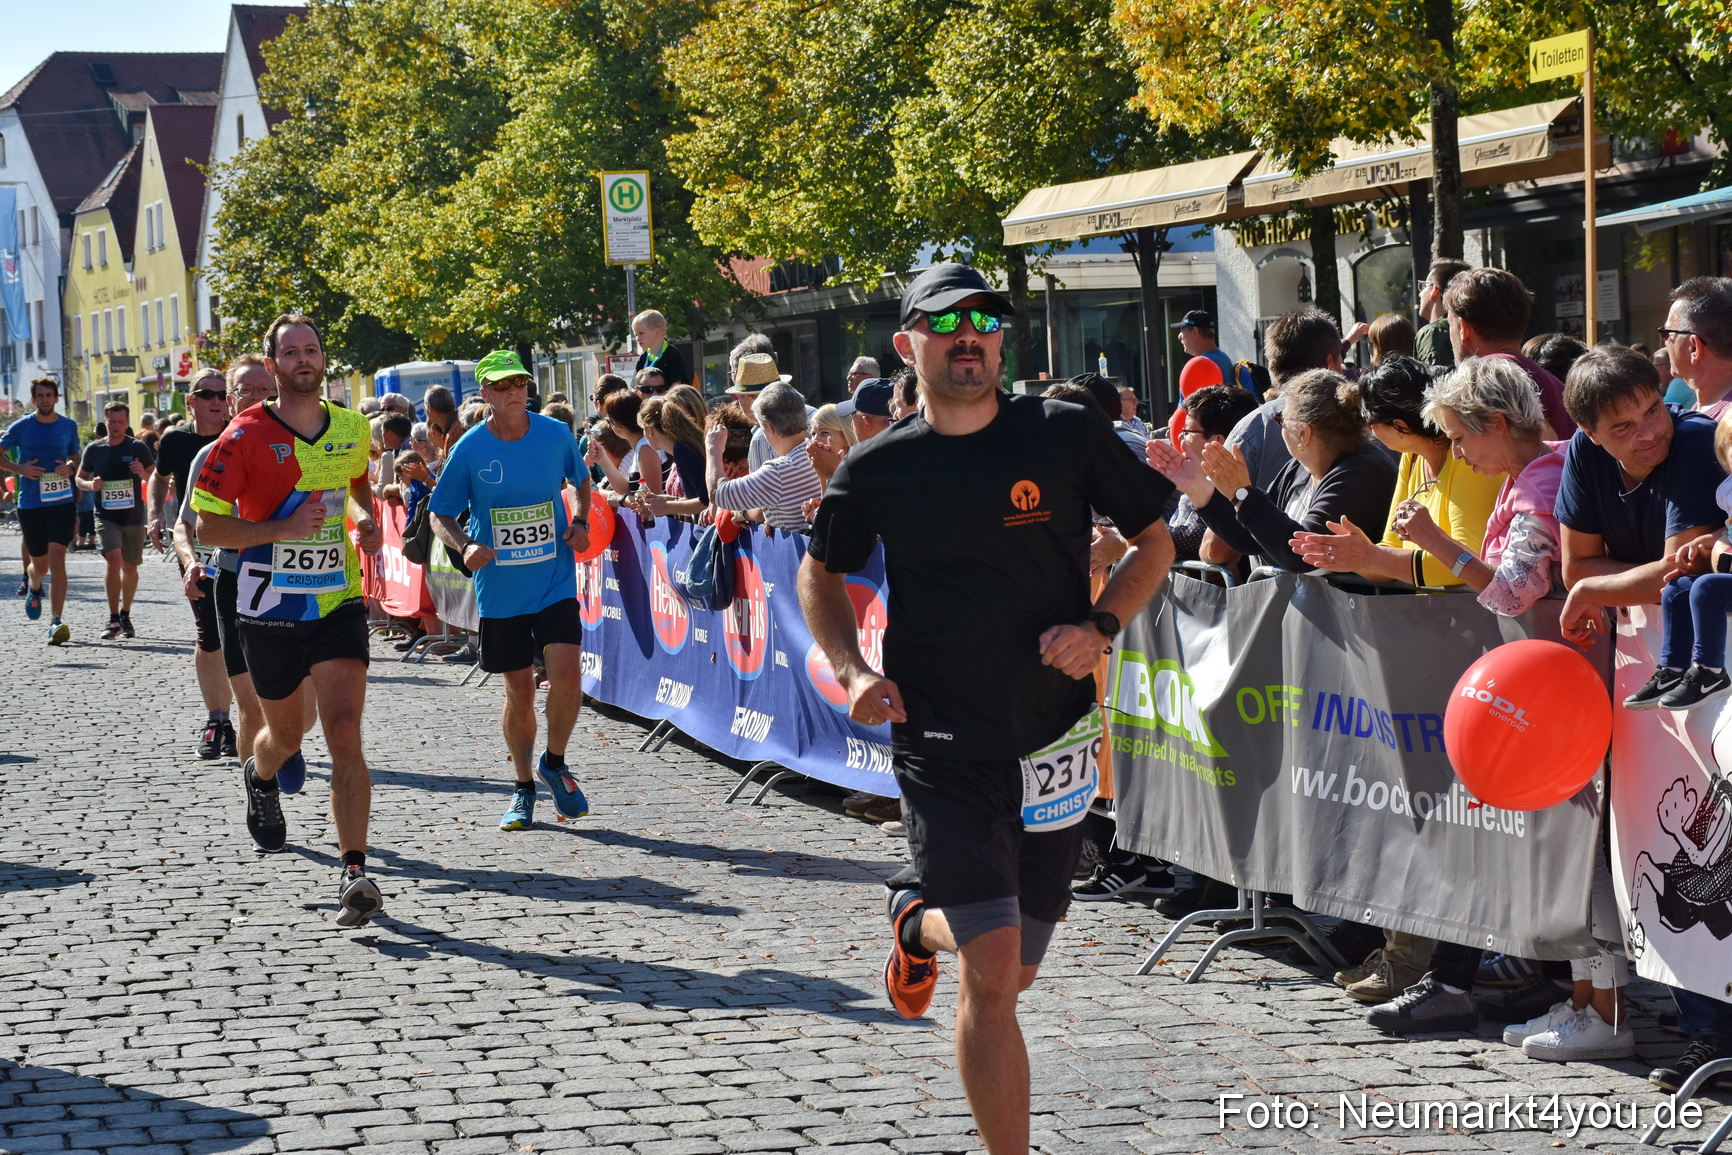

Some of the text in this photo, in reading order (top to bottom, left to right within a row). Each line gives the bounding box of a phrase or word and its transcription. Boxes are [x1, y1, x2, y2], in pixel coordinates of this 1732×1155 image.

[1541, 47, 1583, 68] Toiletten
[617, 185, 635, 206] H
[612, 216, 642, 224] Marktplatz
[44, 480, 68, 492] 2818
[105, 490, 131, 500] 2594
[496, 506, 550, 524] BOCK
[500, 523, 550, 546] 2639
[282, 548, 339, 570] 2679
[511, 547, 544, 559] KLAUS
[604, 549, 619, 562] STORE
[248, 568, 272, 611] 7
[287, 574, 336, 586] CRISTOPH
[653, 564, 688, 628] Hervis
[602, 604, 622, 621] MOBILE
[723, 588, 765, 651] Hervis
[655, 676, 673, 705] GET
[1312, 691, 1446, 753] INDUSTR
[1489, 708, 1526, 733] energie
[923, 731, 953, 741] SPIRO
[846, 736, 867, 769] GET
[1169, 748, 1177, 770] by
[1033, 787, 1091, 822] CHRIST
